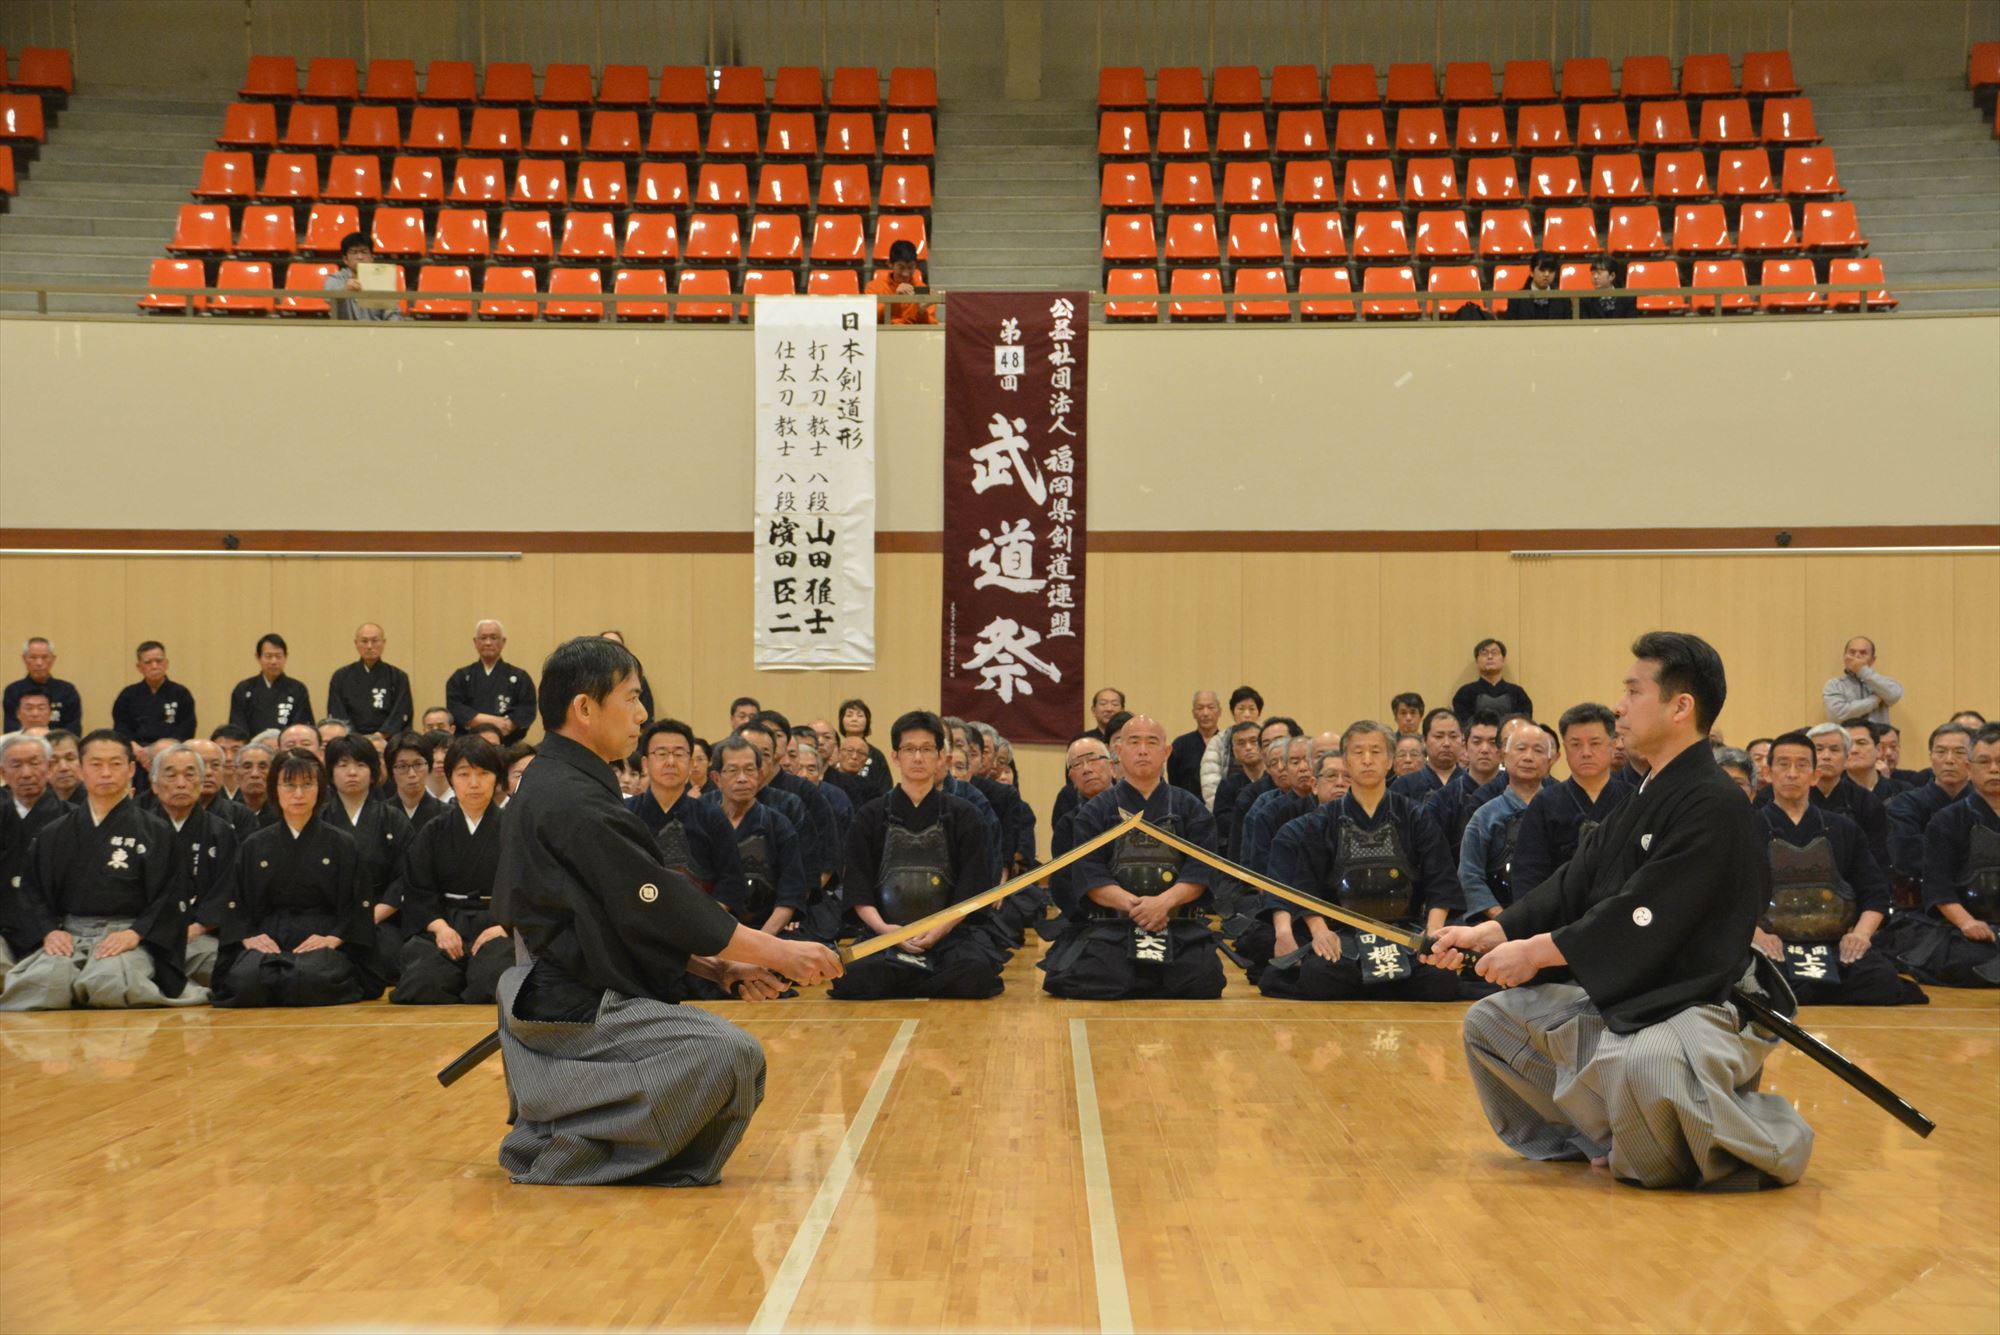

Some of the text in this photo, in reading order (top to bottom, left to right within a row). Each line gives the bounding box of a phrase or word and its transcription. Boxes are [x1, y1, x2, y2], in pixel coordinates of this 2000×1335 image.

[836, 311, 864, 450] 日本剣道形
[1043, 297, 1076, 639] 公益社団法人 福岡県剣道連盟
[769, 515, 801, 634] 濱田臣二
[804, 517, 836, 635] 山田雅士
[961, 412, 1062, 704] 武道祭
